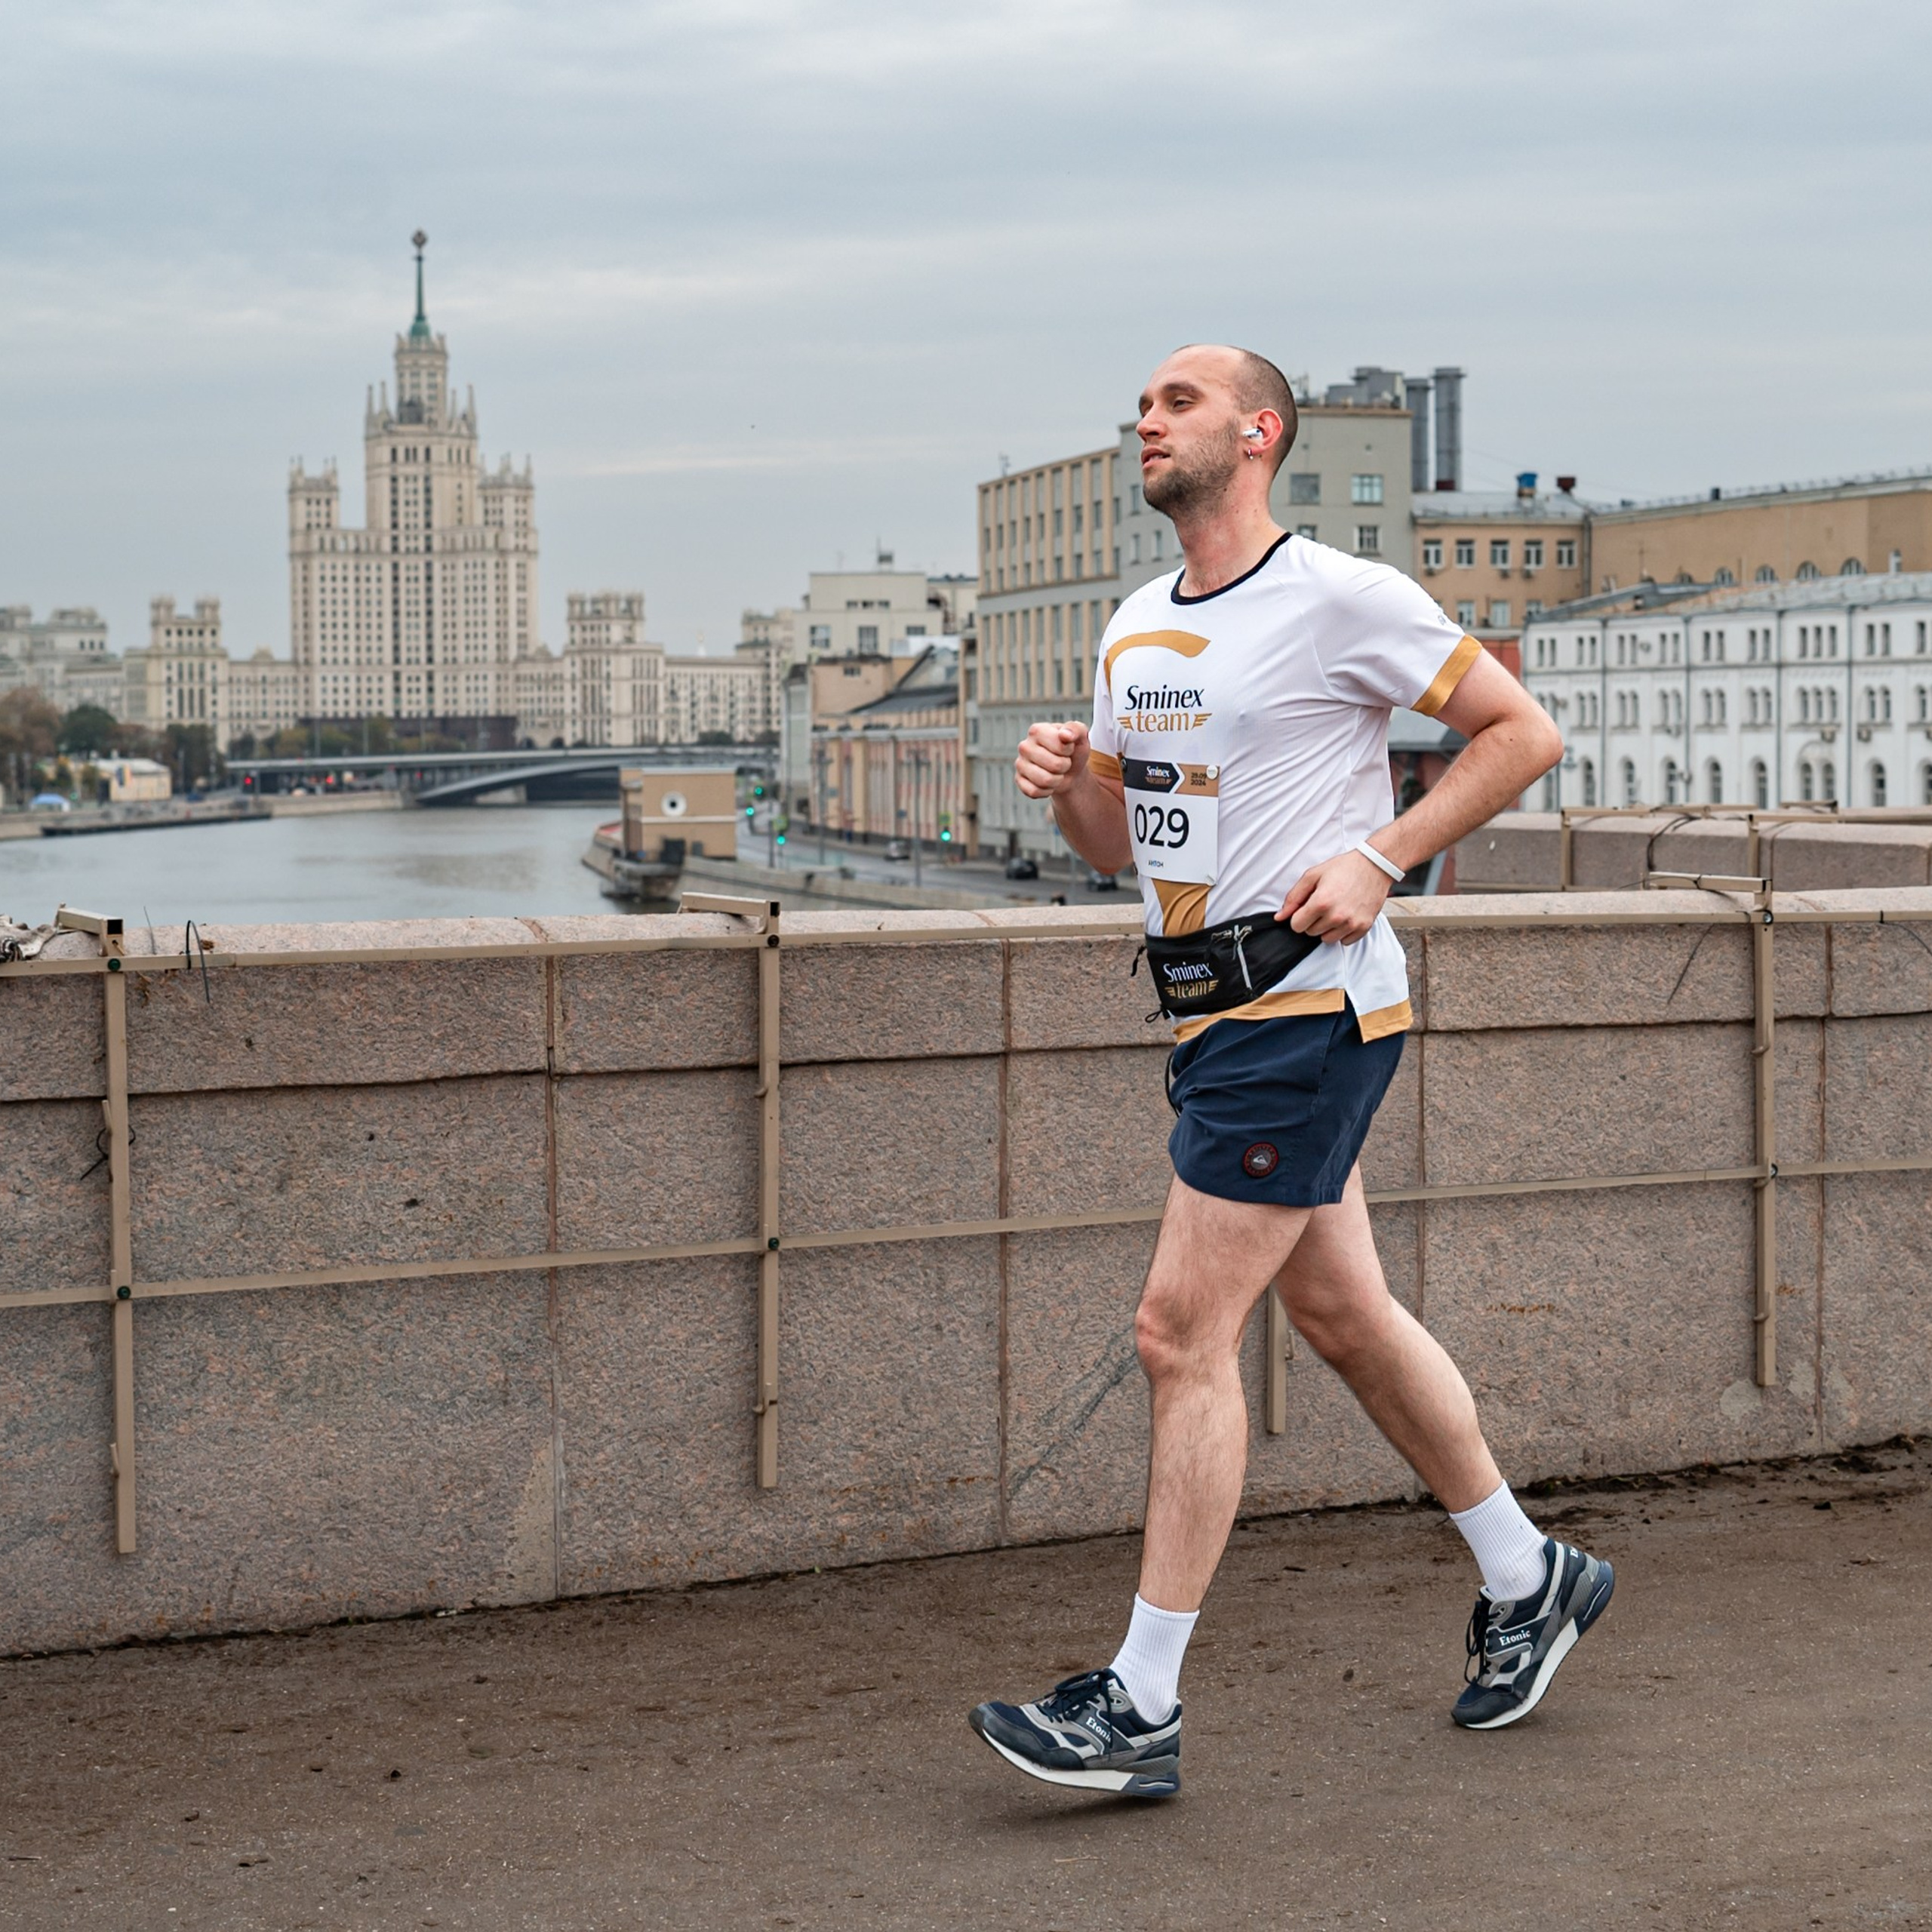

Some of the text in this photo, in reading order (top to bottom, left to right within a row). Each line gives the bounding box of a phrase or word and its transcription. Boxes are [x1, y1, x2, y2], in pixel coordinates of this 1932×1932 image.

[1124, 685, 1205, 710] Sminex
[1136, 712, 1189, 733] team
[1146, 765, 1170, 778] Sminex
[1134, 803, 1190, 849] 029
[1163, 961, 1214, 983] Sminex
[1177, 980, 1207, 998] team
[1499, 1629, 1531, 1646] Etonic
[1086, 1716, 1112, 1743] Etoni
